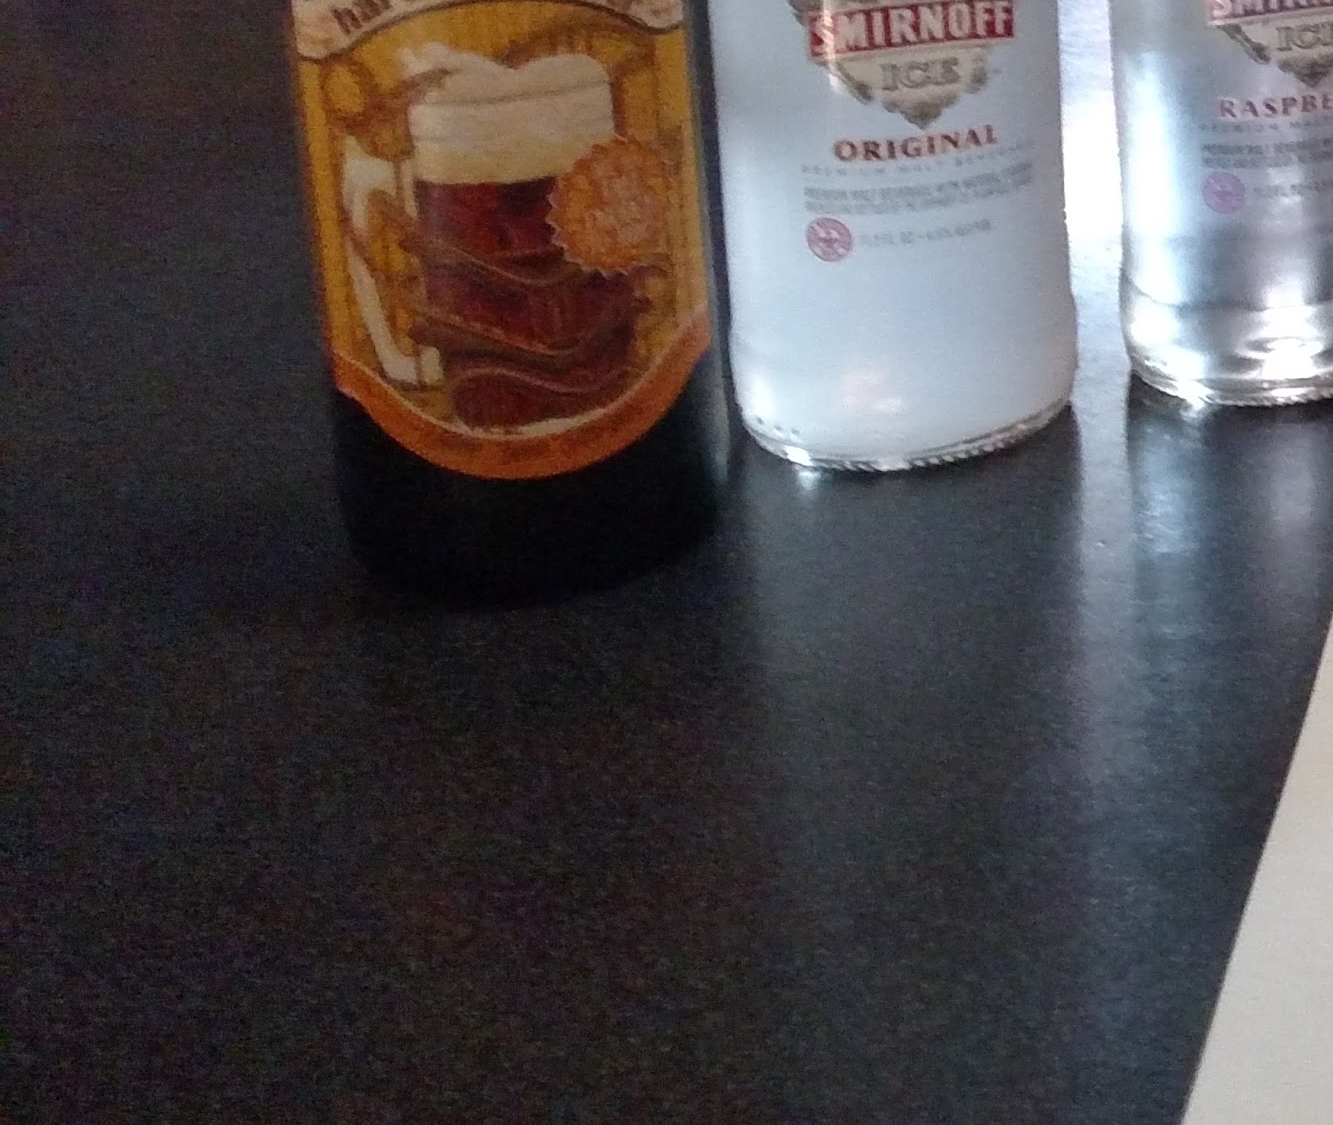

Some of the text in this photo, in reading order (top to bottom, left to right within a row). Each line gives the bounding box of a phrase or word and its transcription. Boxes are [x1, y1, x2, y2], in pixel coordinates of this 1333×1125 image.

[809, 0, 1014, 57] SMIRNOFF
[879, 57, 959, 91] ICE
[832, 124, 999, 162] ORIGINAL
